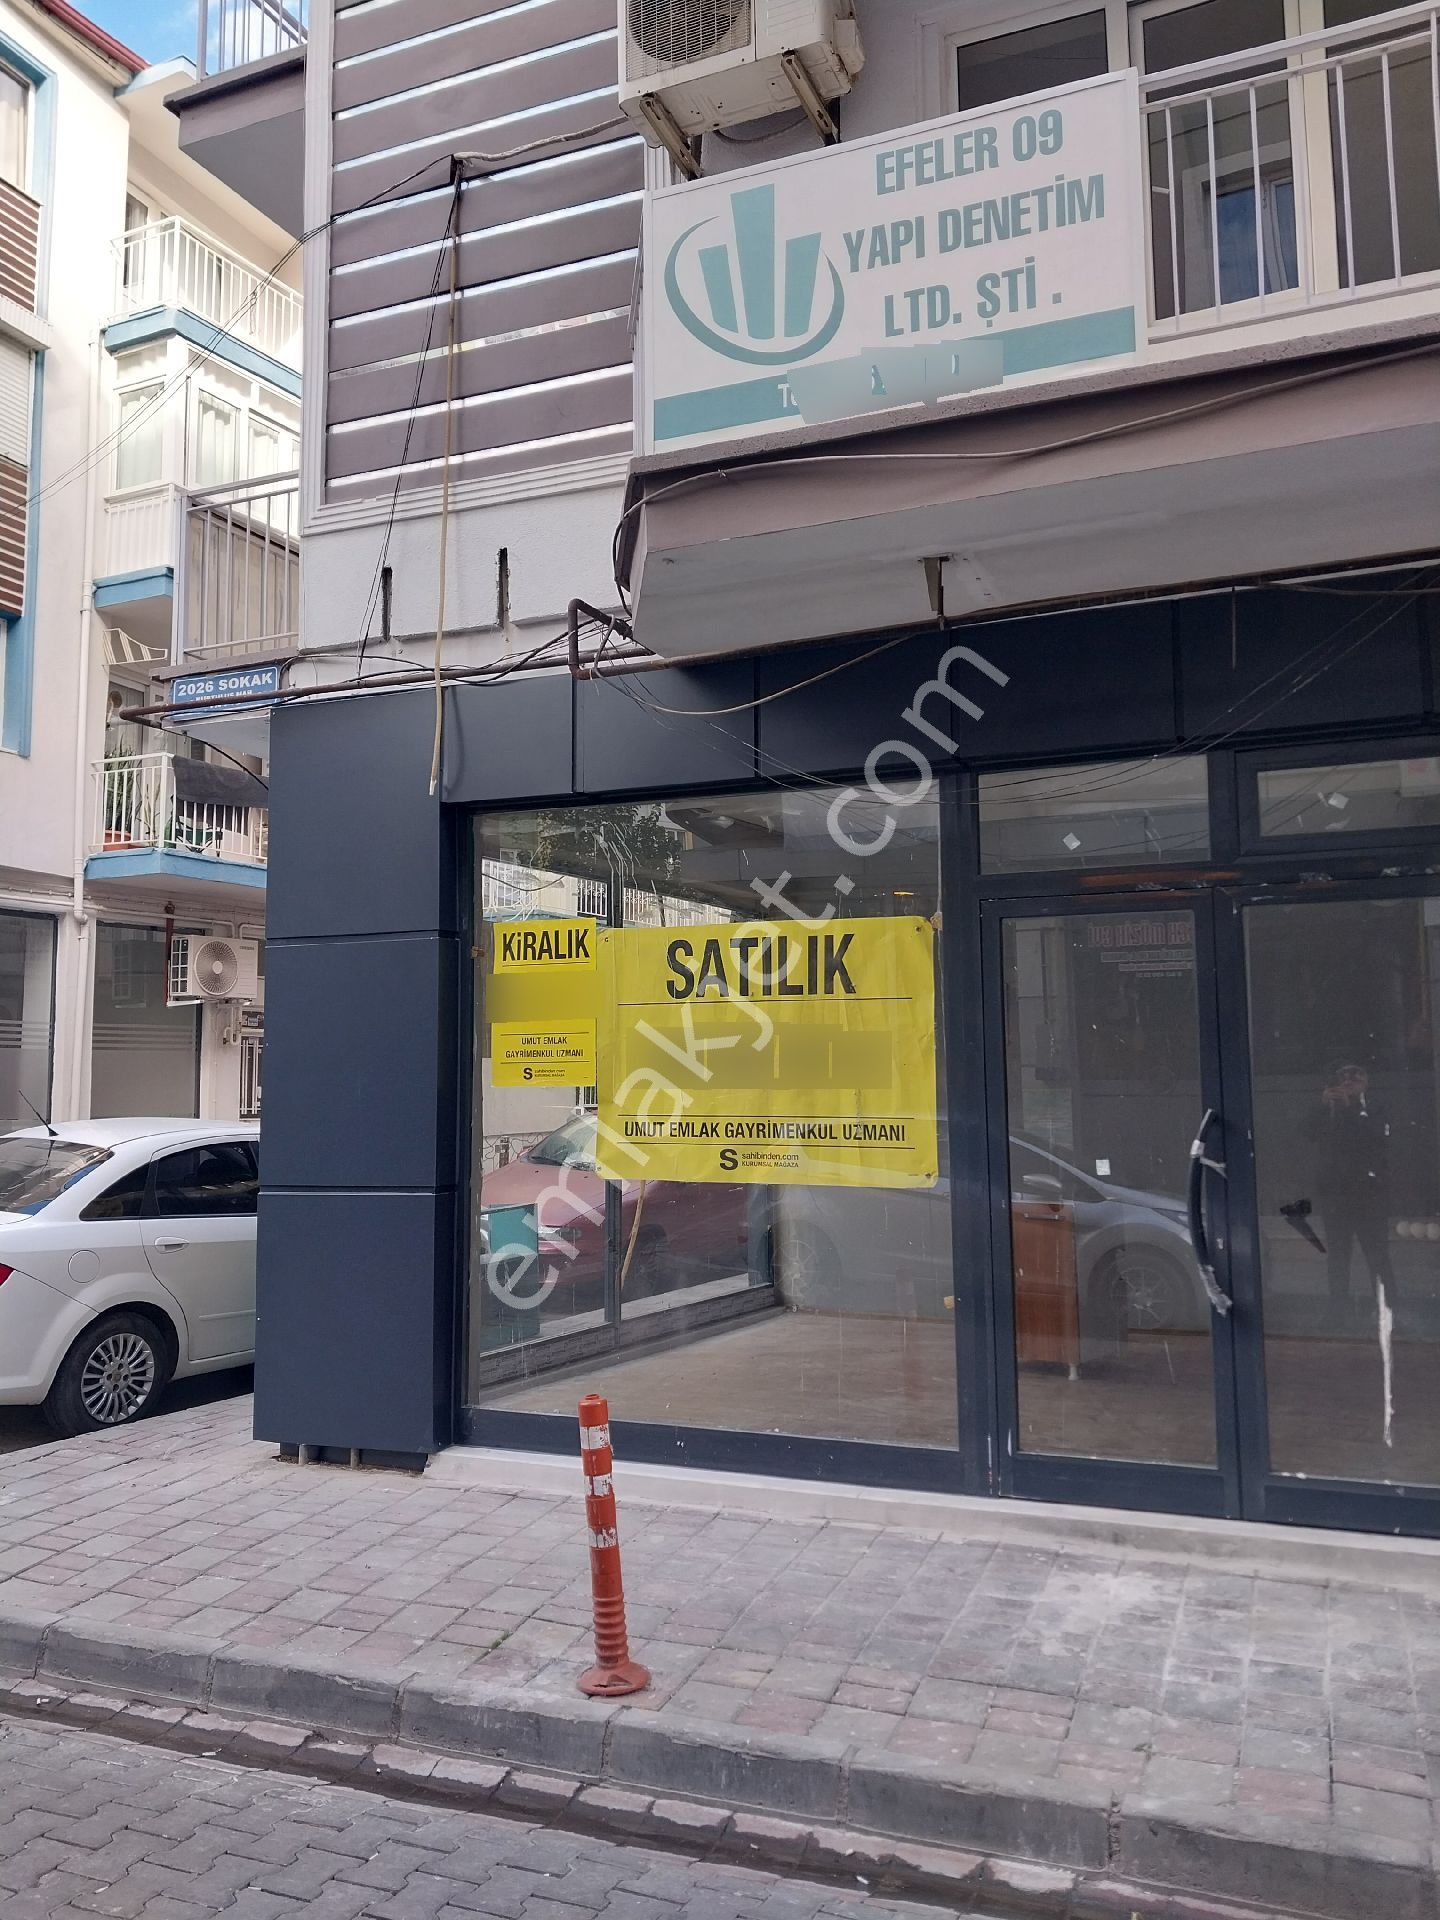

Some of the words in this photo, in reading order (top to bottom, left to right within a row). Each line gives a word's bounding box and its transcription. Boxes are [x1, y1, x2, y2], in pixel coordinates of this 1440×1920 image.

[875, 125, 998, 196] EFELER
[1012, 109, 1064, 162] 09
[842, 215, 925, 273] YAPI
[937, 173, 1105, 255] DENETİM
[884, 283, 961, 338] LTD.
[976, 255, 1036, 328] ŞTİ
[177, 680, 214, 697] 2026
[218, 672, 273, 691] SOKAK
[666, 933, 856, 999] SATILIK
[505, 1048, 554, 1058] GAYRİMENKUL
[556, 1048, 584, 1057] UZMANI
[521, 1037, 541, 1045] UMUT
[543, 1036, 567, 1045] EMLAK
[624, 1121, 664, 1137] UMUT
[670, 1121, 720, 1138] EMLAK
[725, 1119, 837, 1140] GAYRİMENKUL
[843, 1123, 905, 1142] UZMANI
[741, 1152, 799, 1161] sahibinden.com
